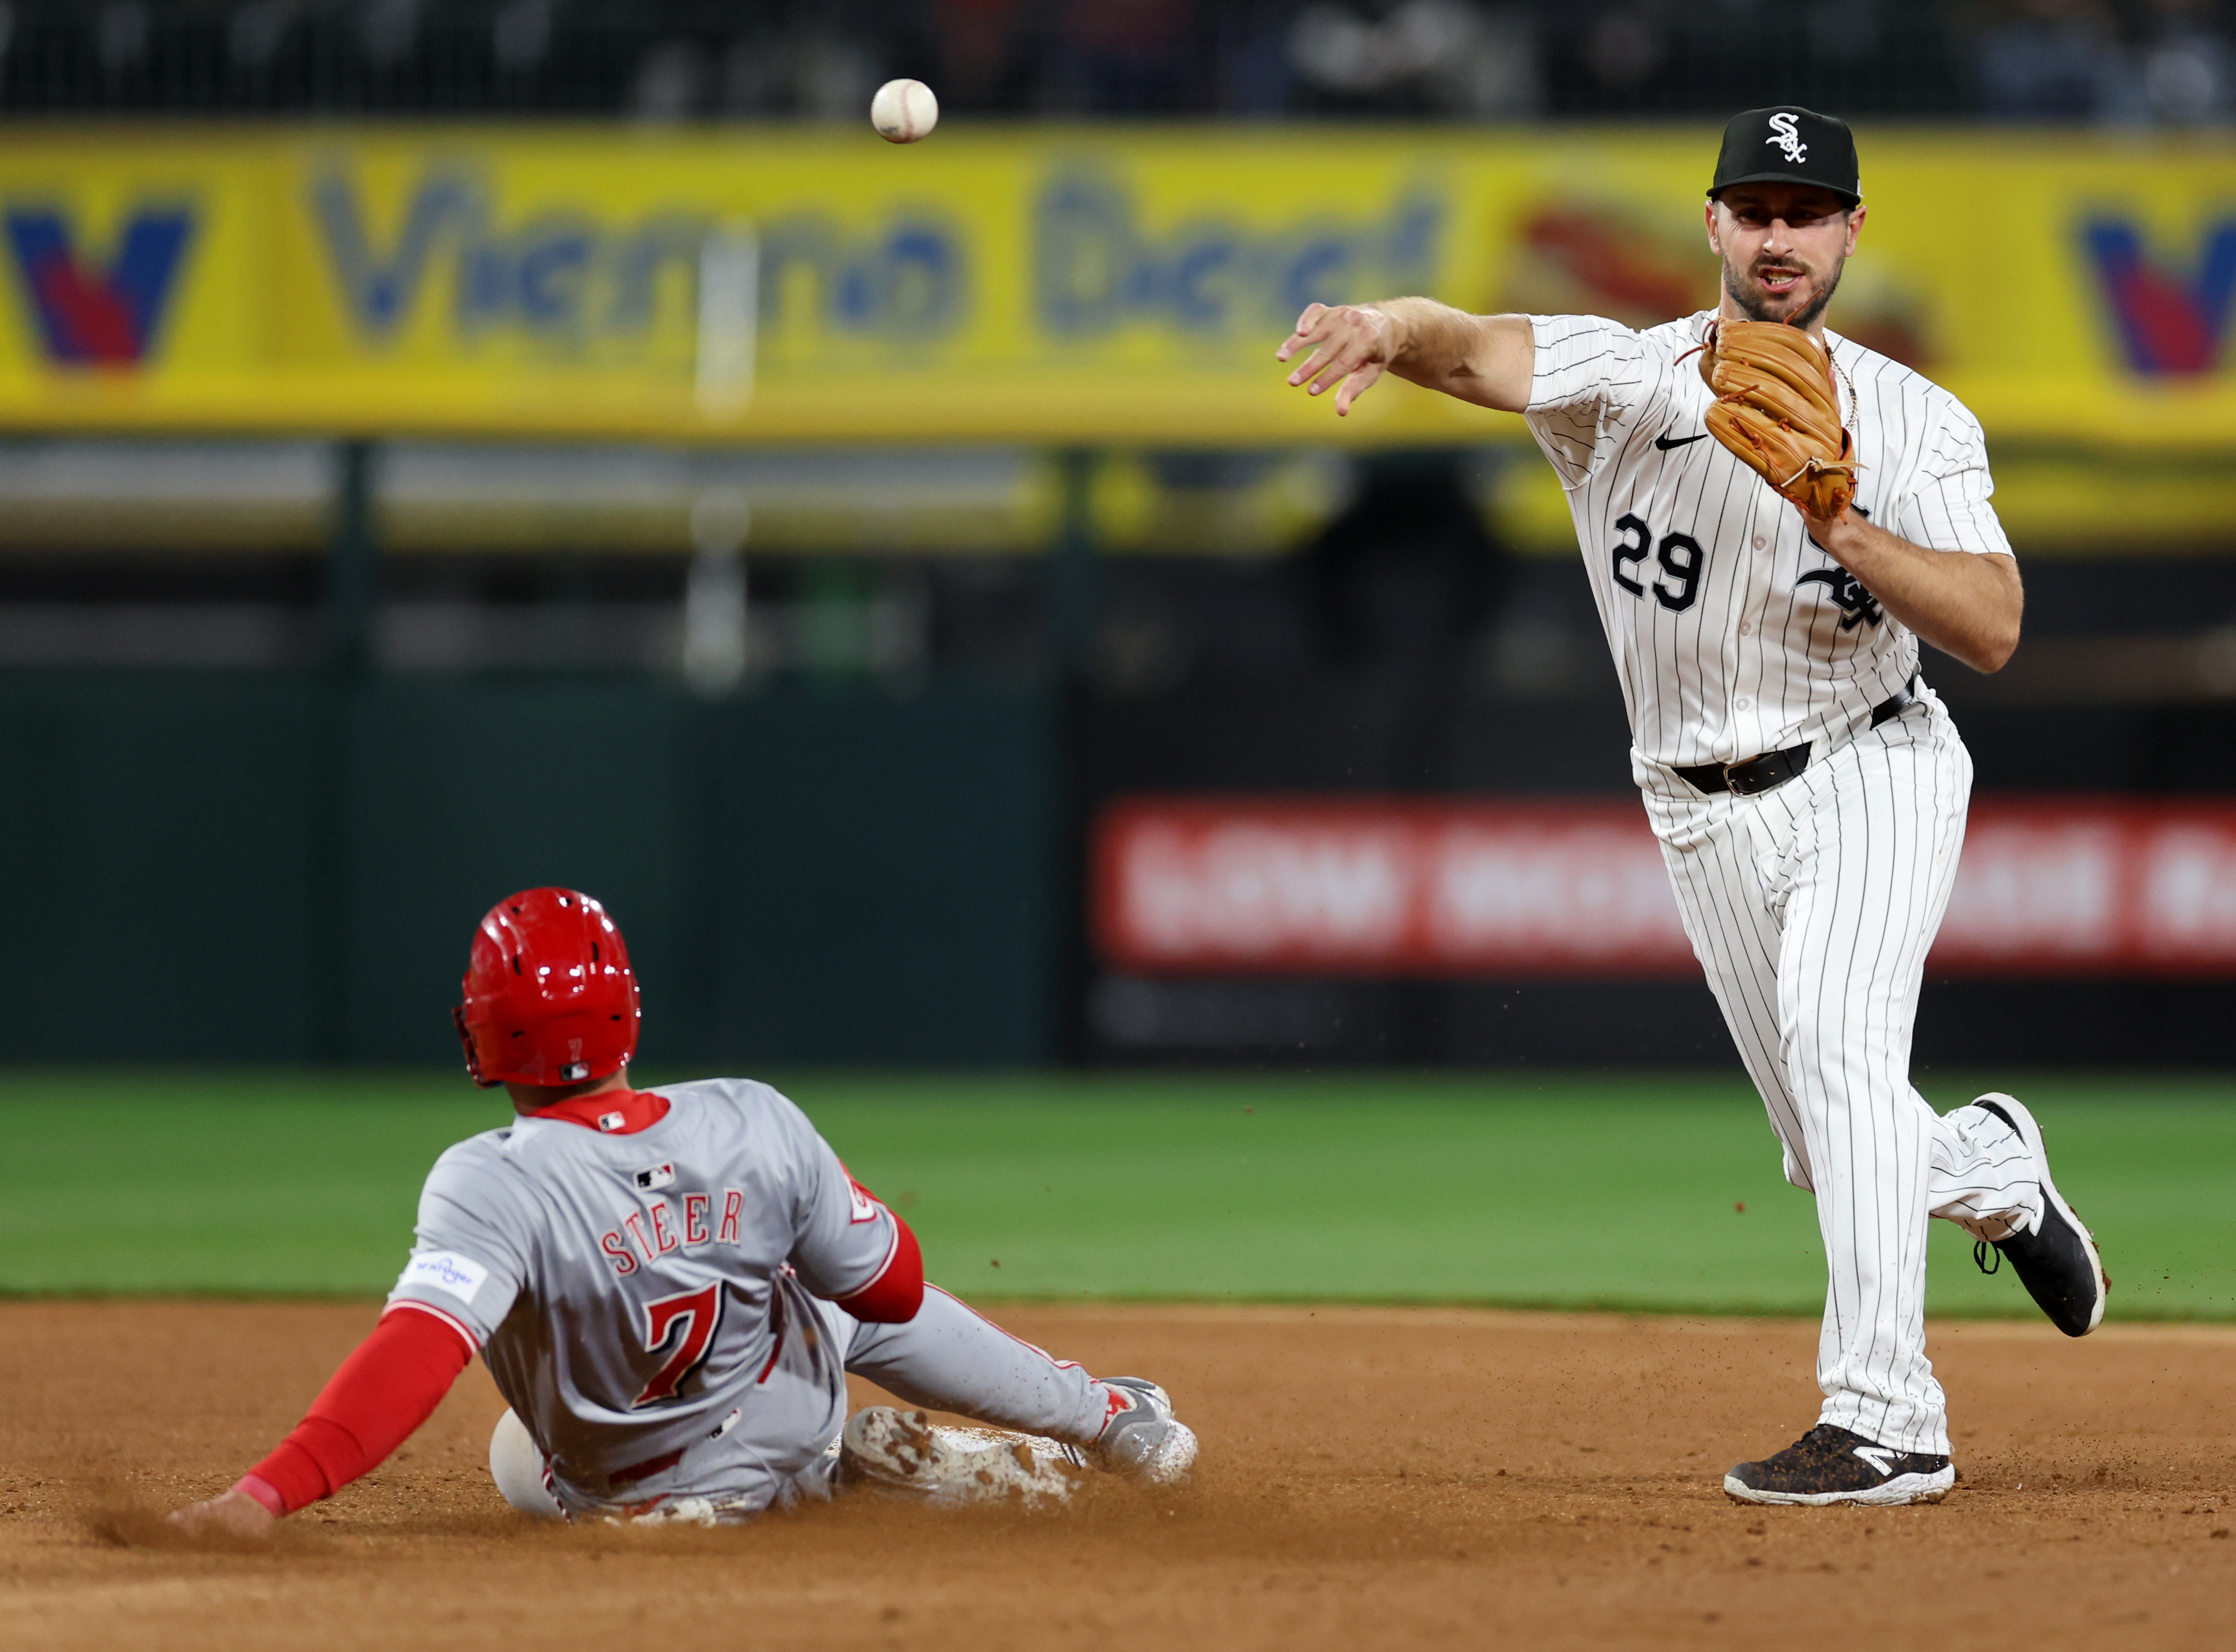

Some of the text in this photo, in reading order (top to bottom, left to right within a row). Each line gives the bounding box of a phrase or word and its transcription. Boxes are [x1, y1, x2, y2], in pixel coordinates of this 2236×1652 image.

[1613, 512, 1704, 614] 29
[600, 1187, 745, 1277] STEER
[629, 1278, 727, 1410] 7
